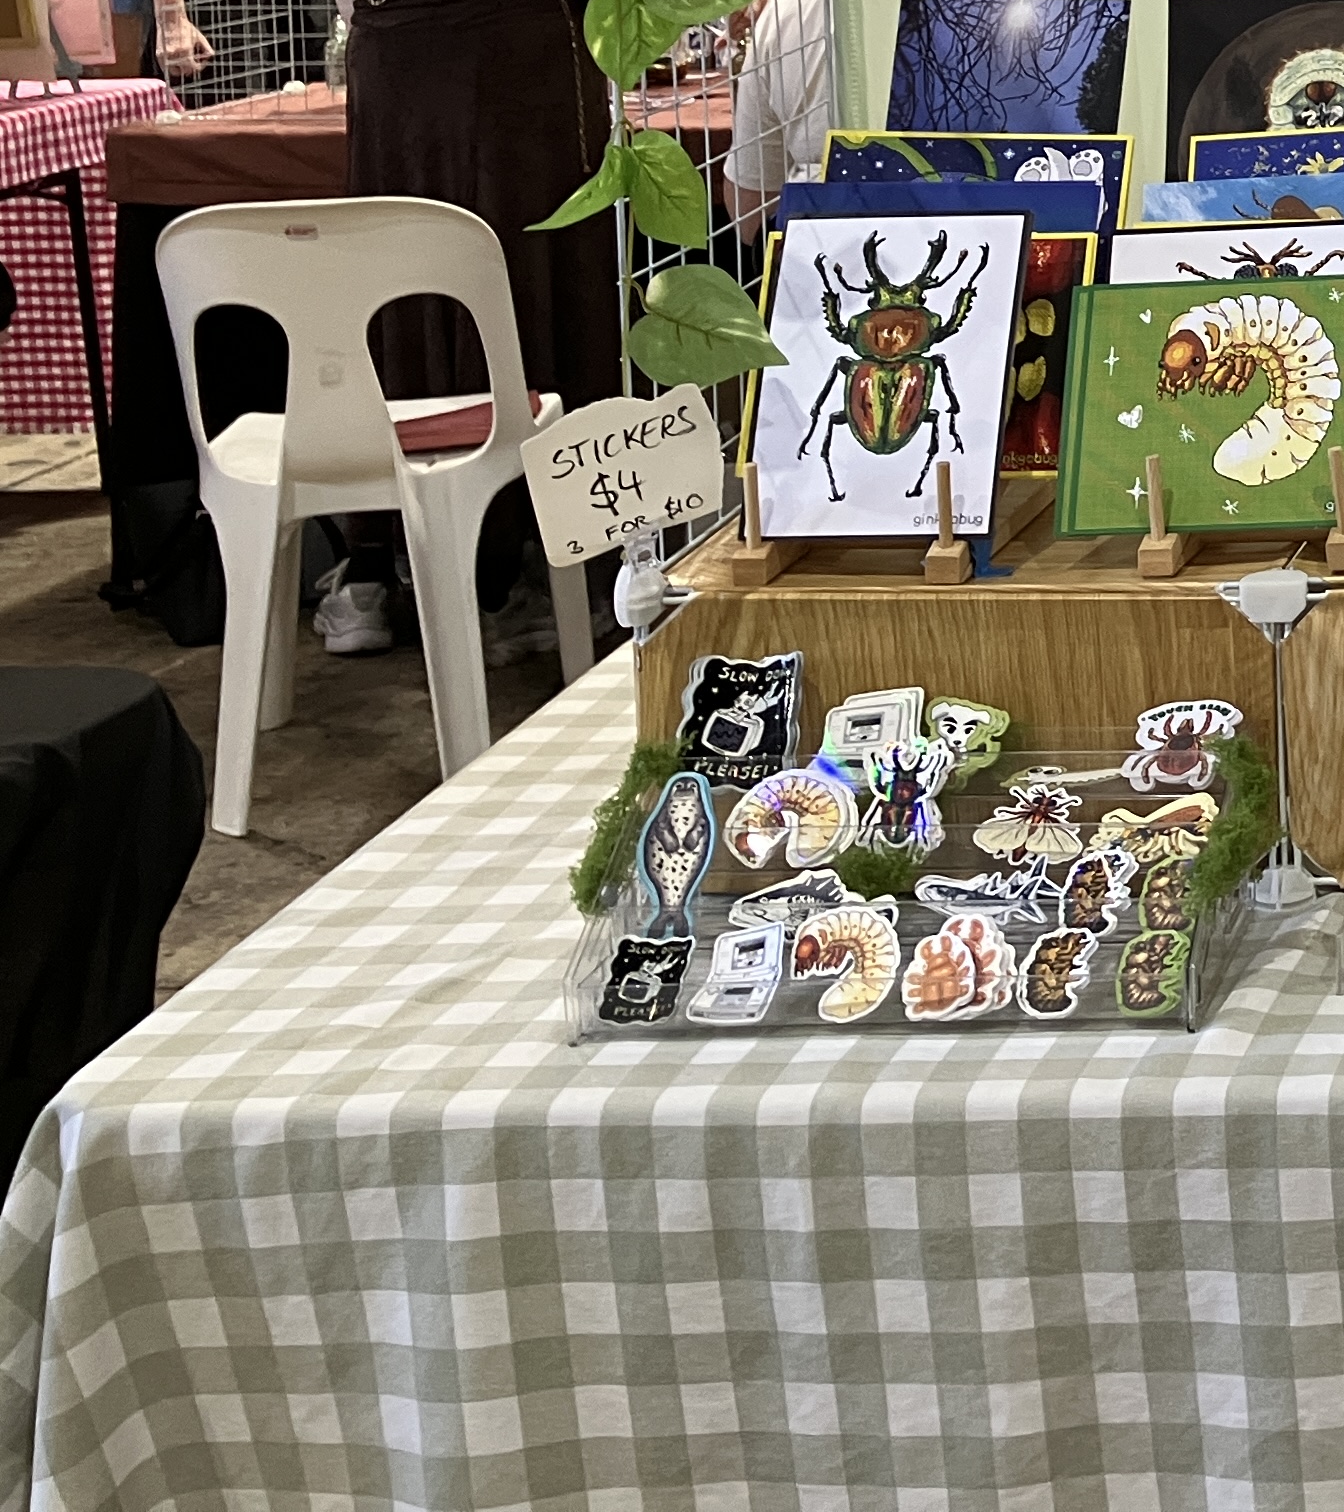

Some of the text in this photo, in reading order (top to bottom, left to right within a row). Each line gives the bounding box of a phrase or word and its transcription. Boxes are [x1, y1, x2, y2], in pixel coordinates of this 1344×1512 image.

[552, 405, 697, 480] STICKERS
[1002, 450, 1058, 466] nkgobug
[590, 469, 646, 516] $4
[567, 493, 704, 555] 3 FOR $10
[718, 667, 760, 683] SLOW
[693, 759, 769, 780] PLEASE!
